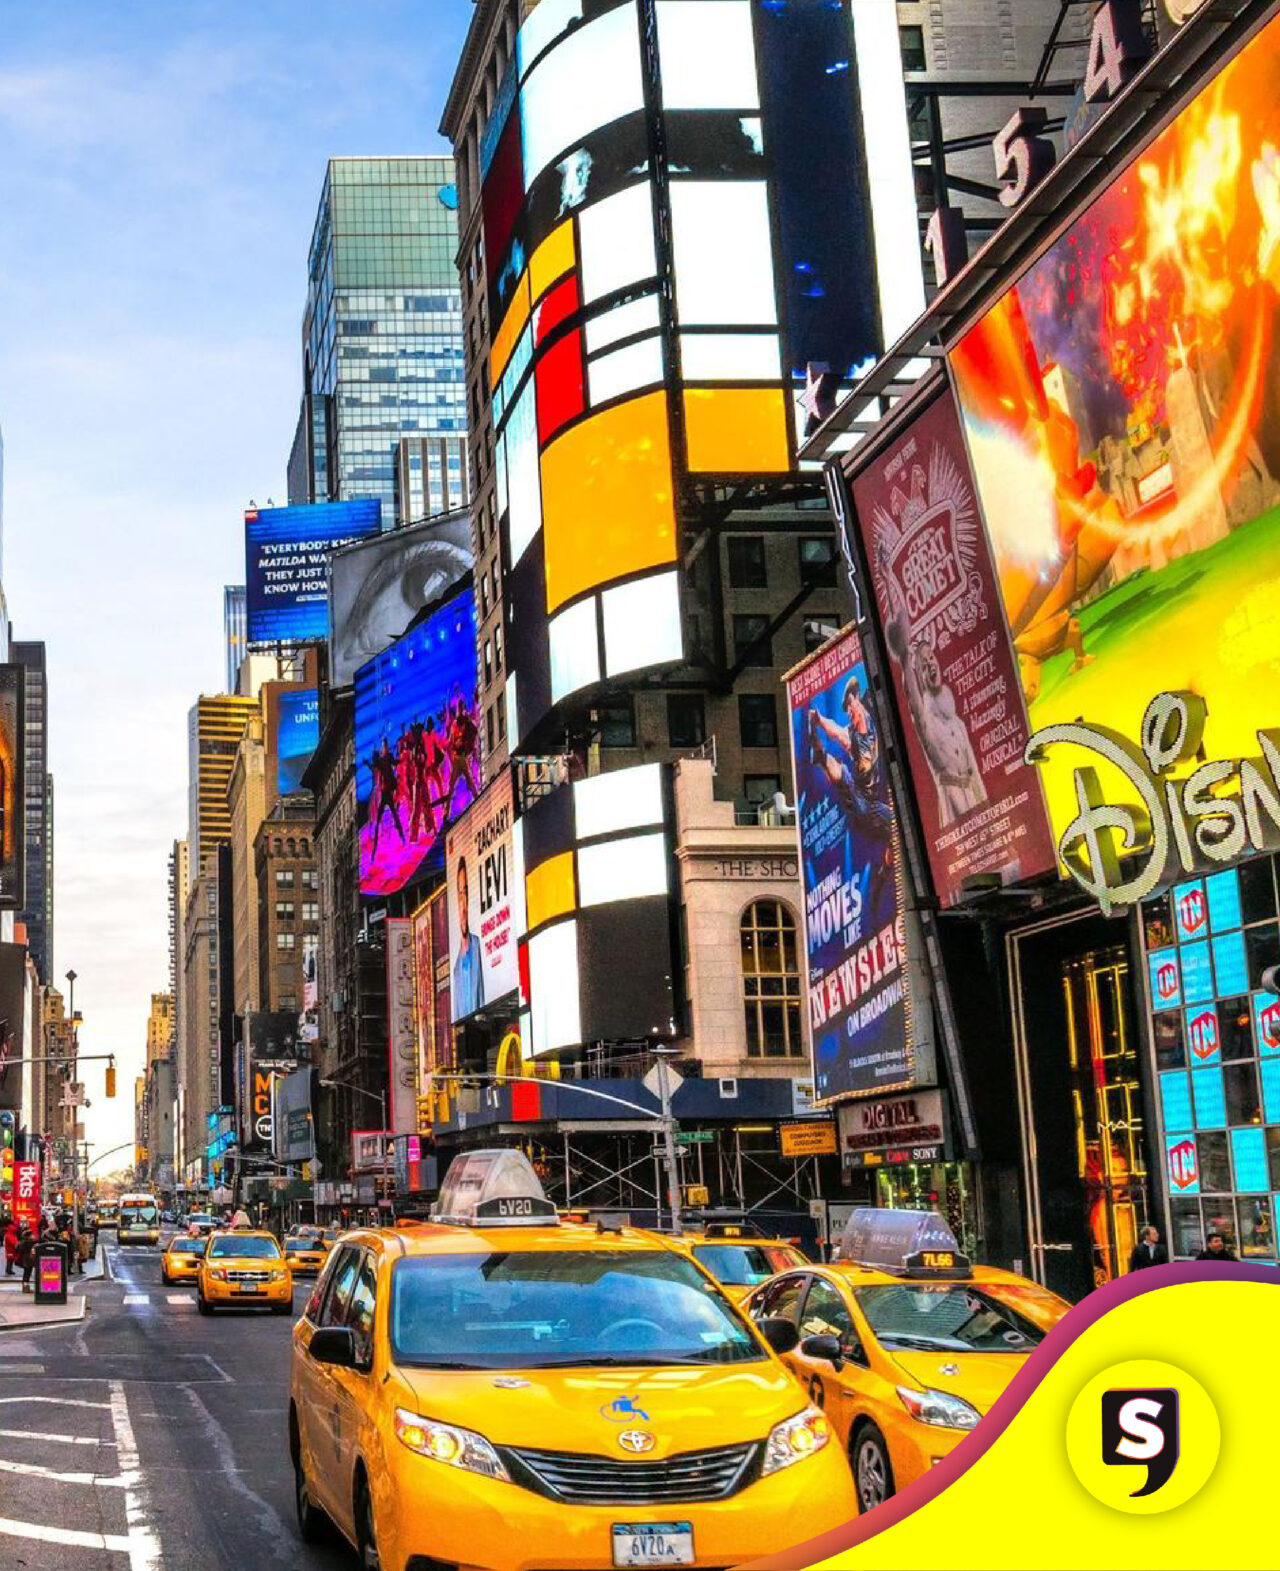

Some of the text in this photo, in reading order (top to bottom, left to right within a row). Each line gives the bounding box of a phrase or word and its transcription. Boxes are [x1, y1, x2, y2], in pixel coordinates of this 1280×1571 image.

[258, 556, 306, 568] MATILDA
[902, 526, 946, 588] GREAT
[264, 582, 299, 594] KNOW
[265, 568, 322, 581] THEY JUST
[905, 553, 956, 618] COMET
[963, 642, 985, 669] TALK
[986, 630, 998, 652] OF
[955, 671, 974, 696] THE
[979, 714, 1019, 752] ORIGINAL
[479, 843, 508, 914] LEVI
[719, 861, 798, 876] THE SHO
[807, 866, 842, 913] NOTHING
[808, 872, 862, 947] MOVES
[1180, 891, 1203, 922] IN
[844, 916, 861, 949] LIKE
[809, 915, 907, 1029] NEWSIES
[1158, 967, 1175, 990] IN
[847, 977, 906, 1037] ON BROADWA
[1192, 1018, 1216, 1051] IN
[913, 1148, 937, 1160] SONY
[1172, 1145, 1196, 1181] IN
[19, 1165, 36, 1198] tkts
[923, 1253, 953, 1267] 7L66
